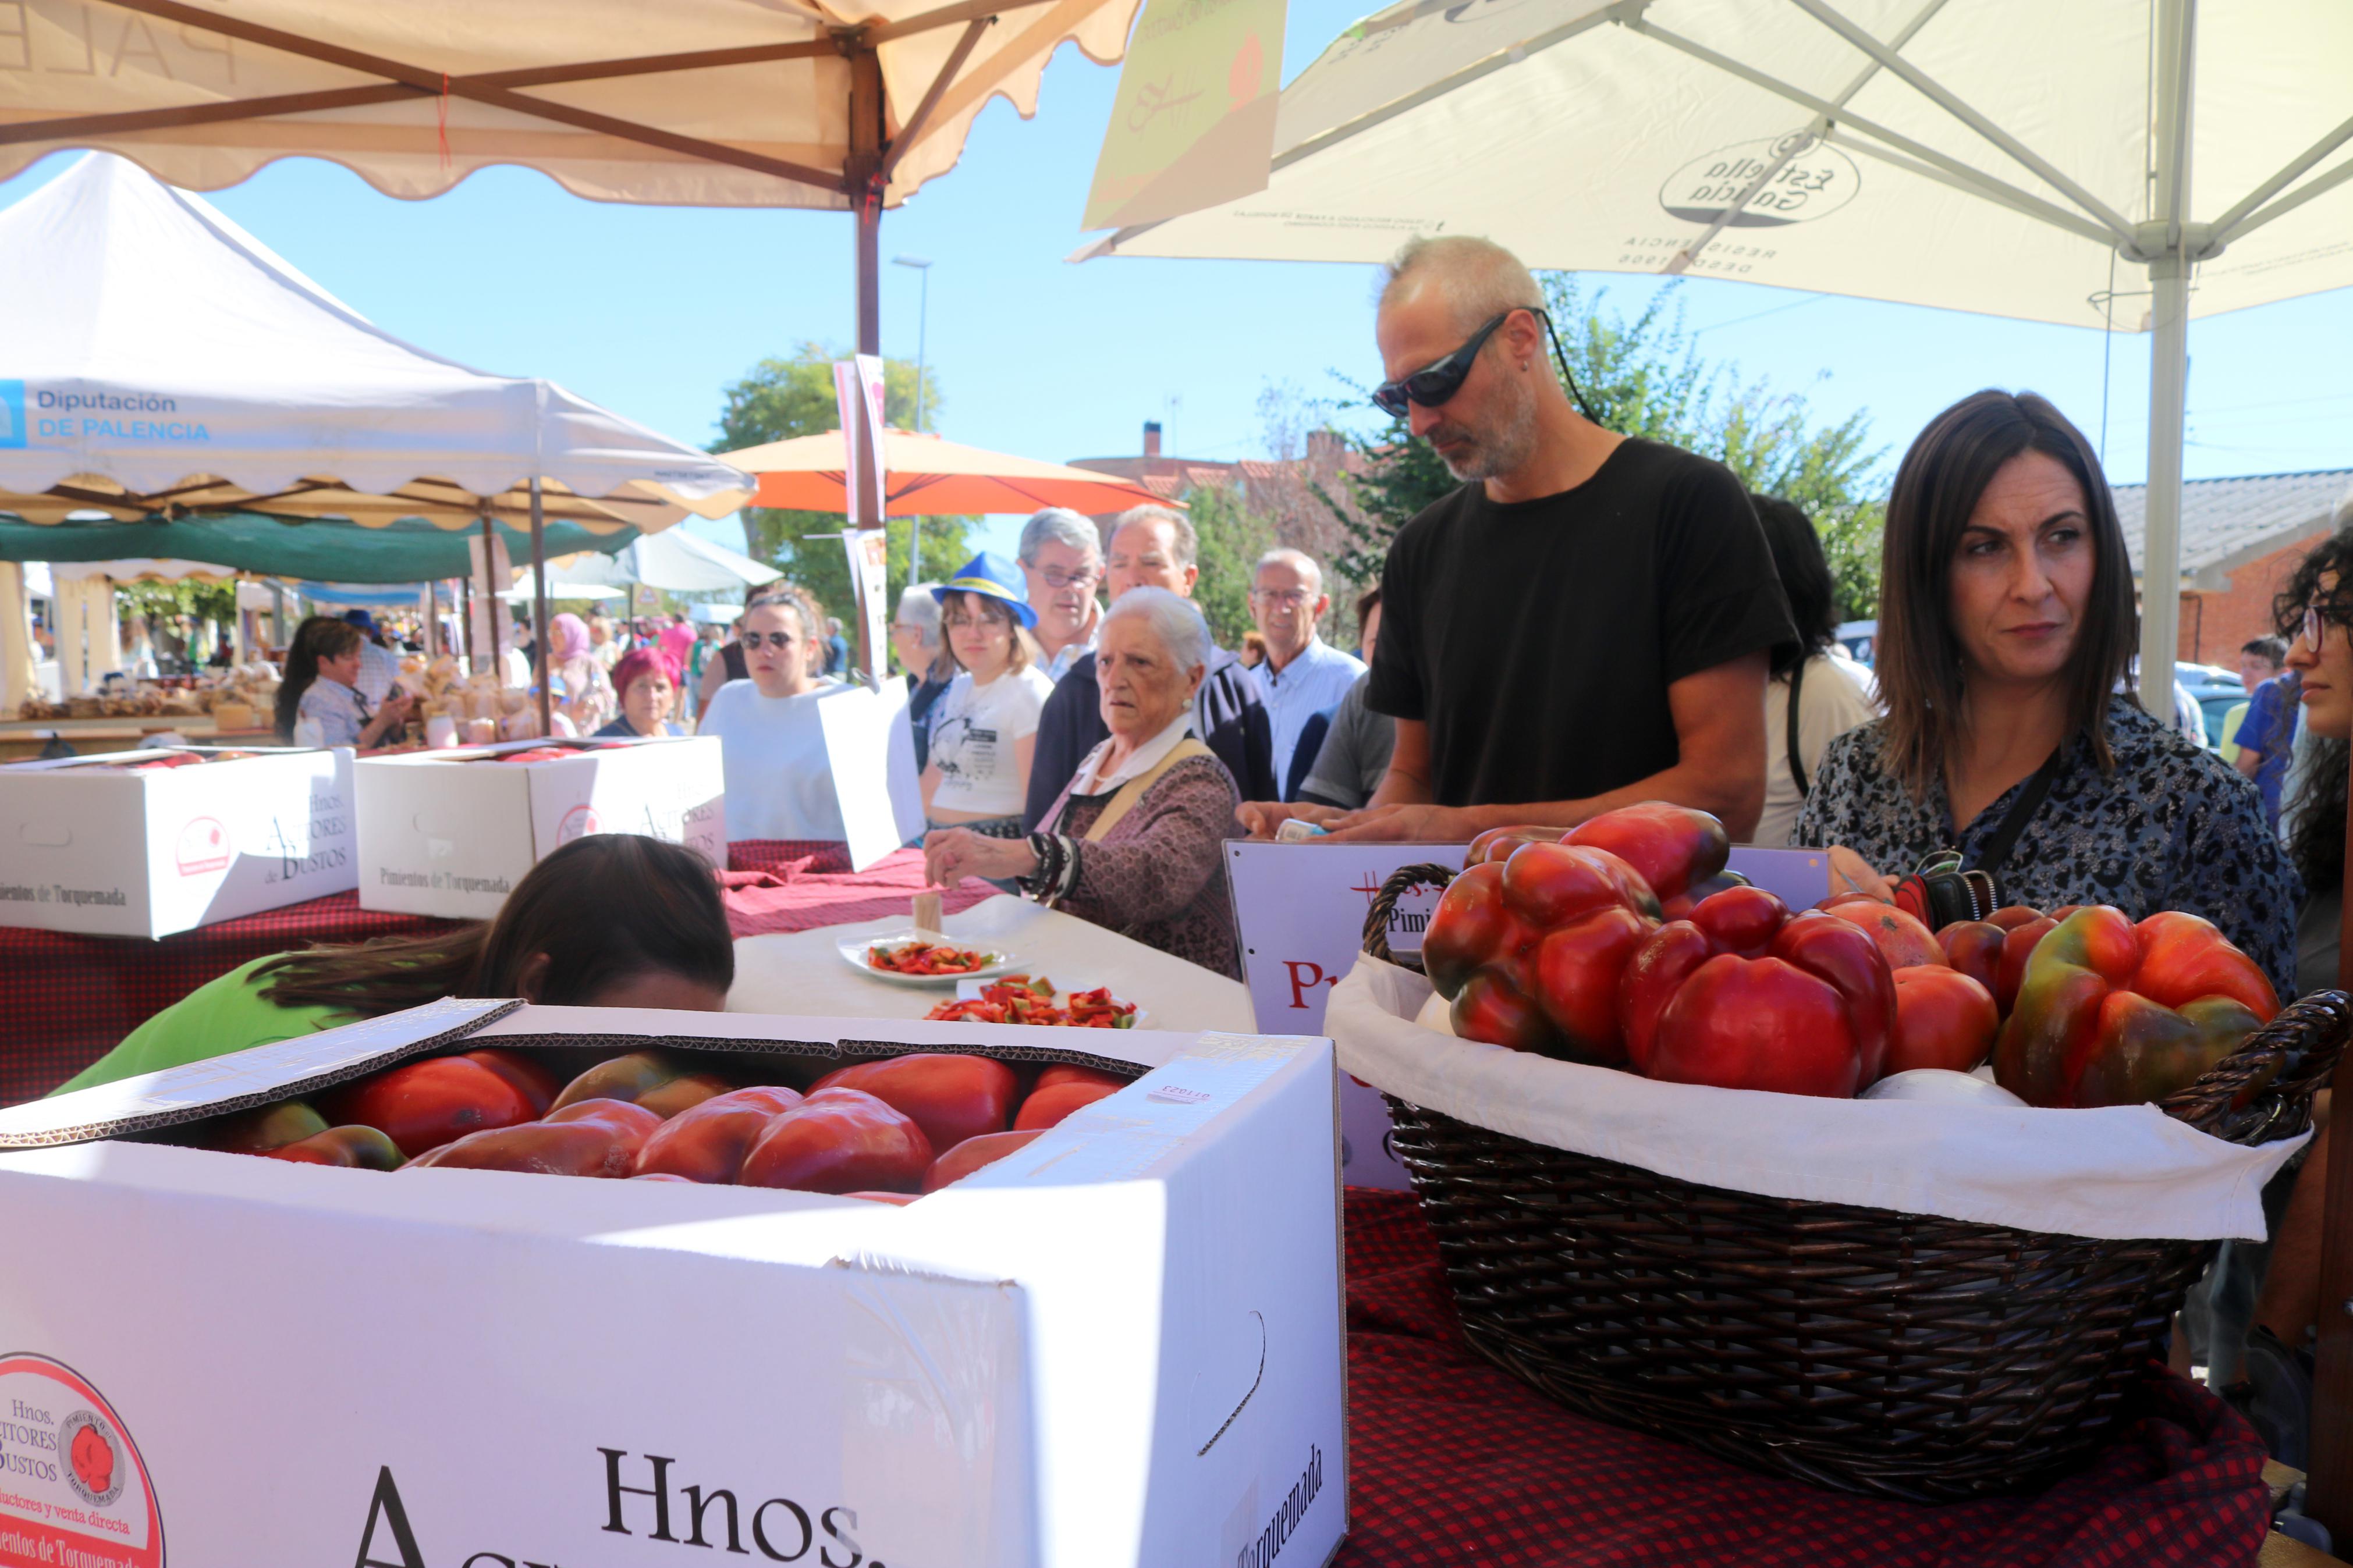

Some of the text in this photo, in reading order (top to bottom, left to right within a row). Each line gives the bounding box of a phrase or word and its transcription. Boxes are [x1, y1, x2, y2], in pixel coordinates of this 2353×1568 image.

[37, 390, 178, 411] Diputación
[38, 418, 211, 441] DE PALENCIA
[380, 867, 428, 887] Pimientos
[445, 872, 509, 893] Torquemada
[12, 1399, 54, 1425] Hnos.
[0, 1421, 56, 1451] ITORES
[44, 1503, 52, 1519] y
[54, 1505, 86, 1524] venta
[0, 1531, 36, 1558] entos
[38, 1535, 54, 1563] de
